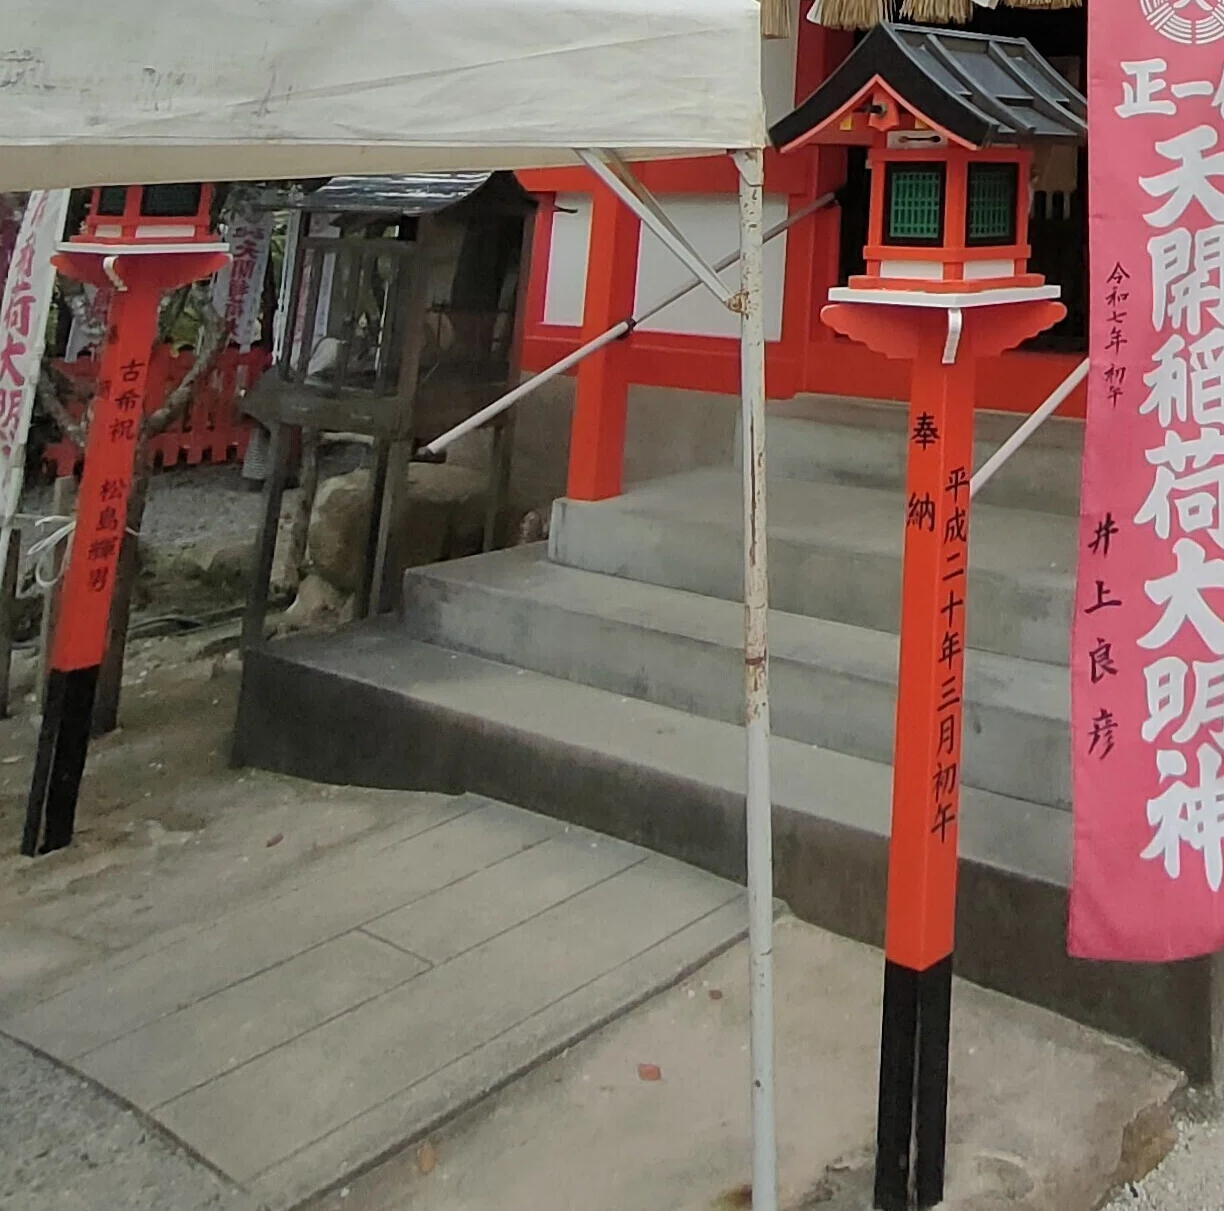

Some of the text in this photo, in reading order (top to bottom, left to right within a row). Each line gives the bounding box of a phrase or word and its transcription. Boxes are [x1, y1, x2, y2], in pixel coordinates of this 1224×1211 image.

[1104, 261, 1131, 355] 令和七年
[905, 410, 941, 532] 奉納
